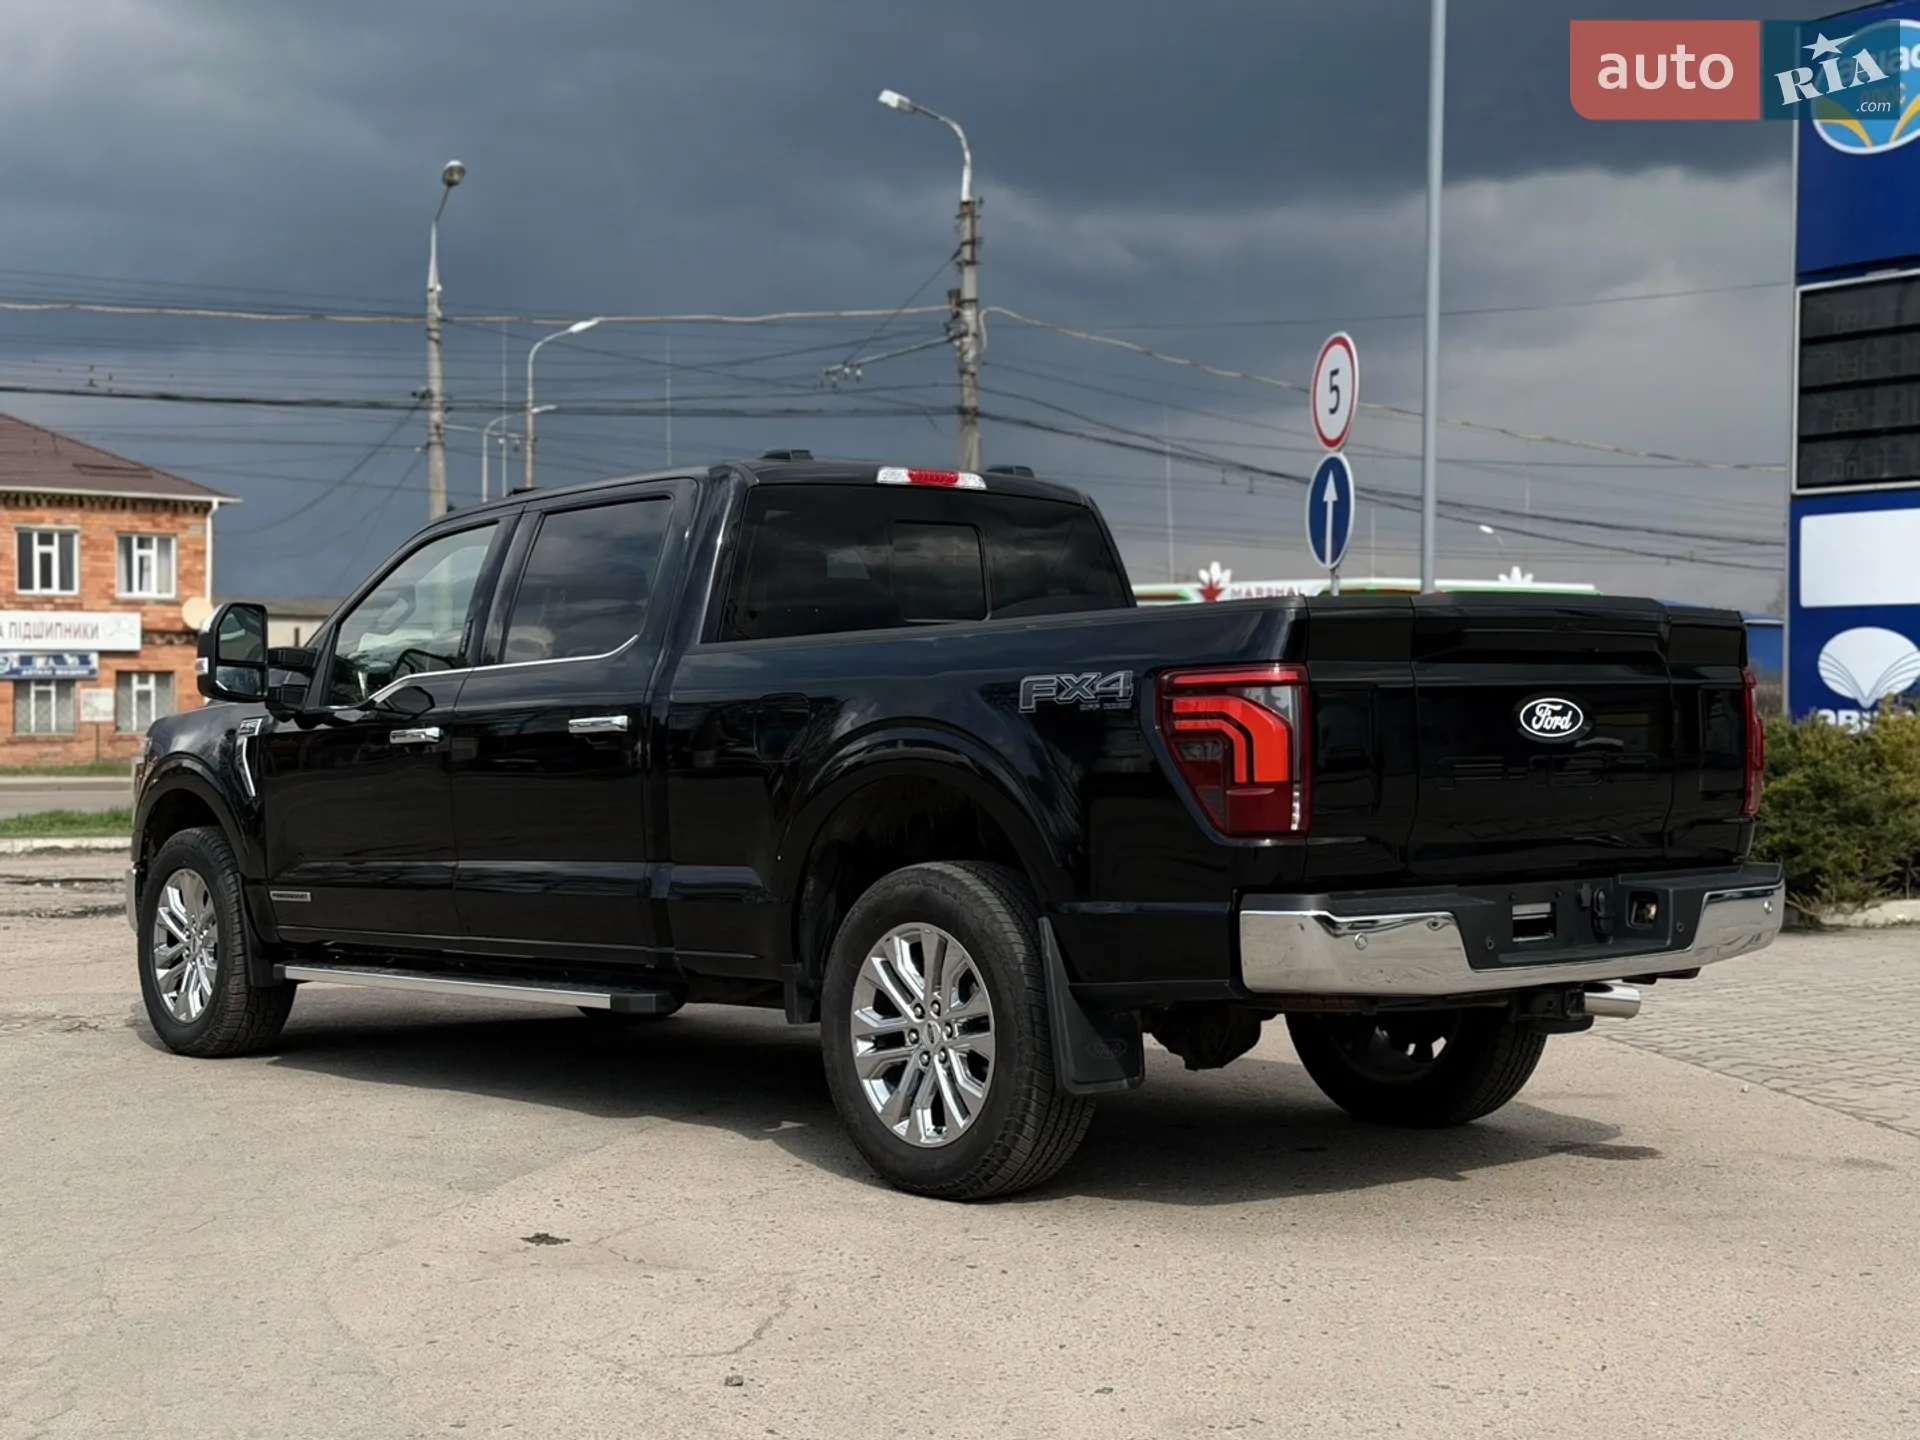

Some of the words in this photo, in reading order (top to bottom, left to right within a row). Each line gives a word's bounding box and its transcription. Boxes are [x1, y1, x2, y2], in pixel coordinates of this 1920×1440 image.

[1328, 368, 1341, 415] 5
[1019, 670, 1133, 713] FX4
[1532, 703, 1573, 730] Ford
